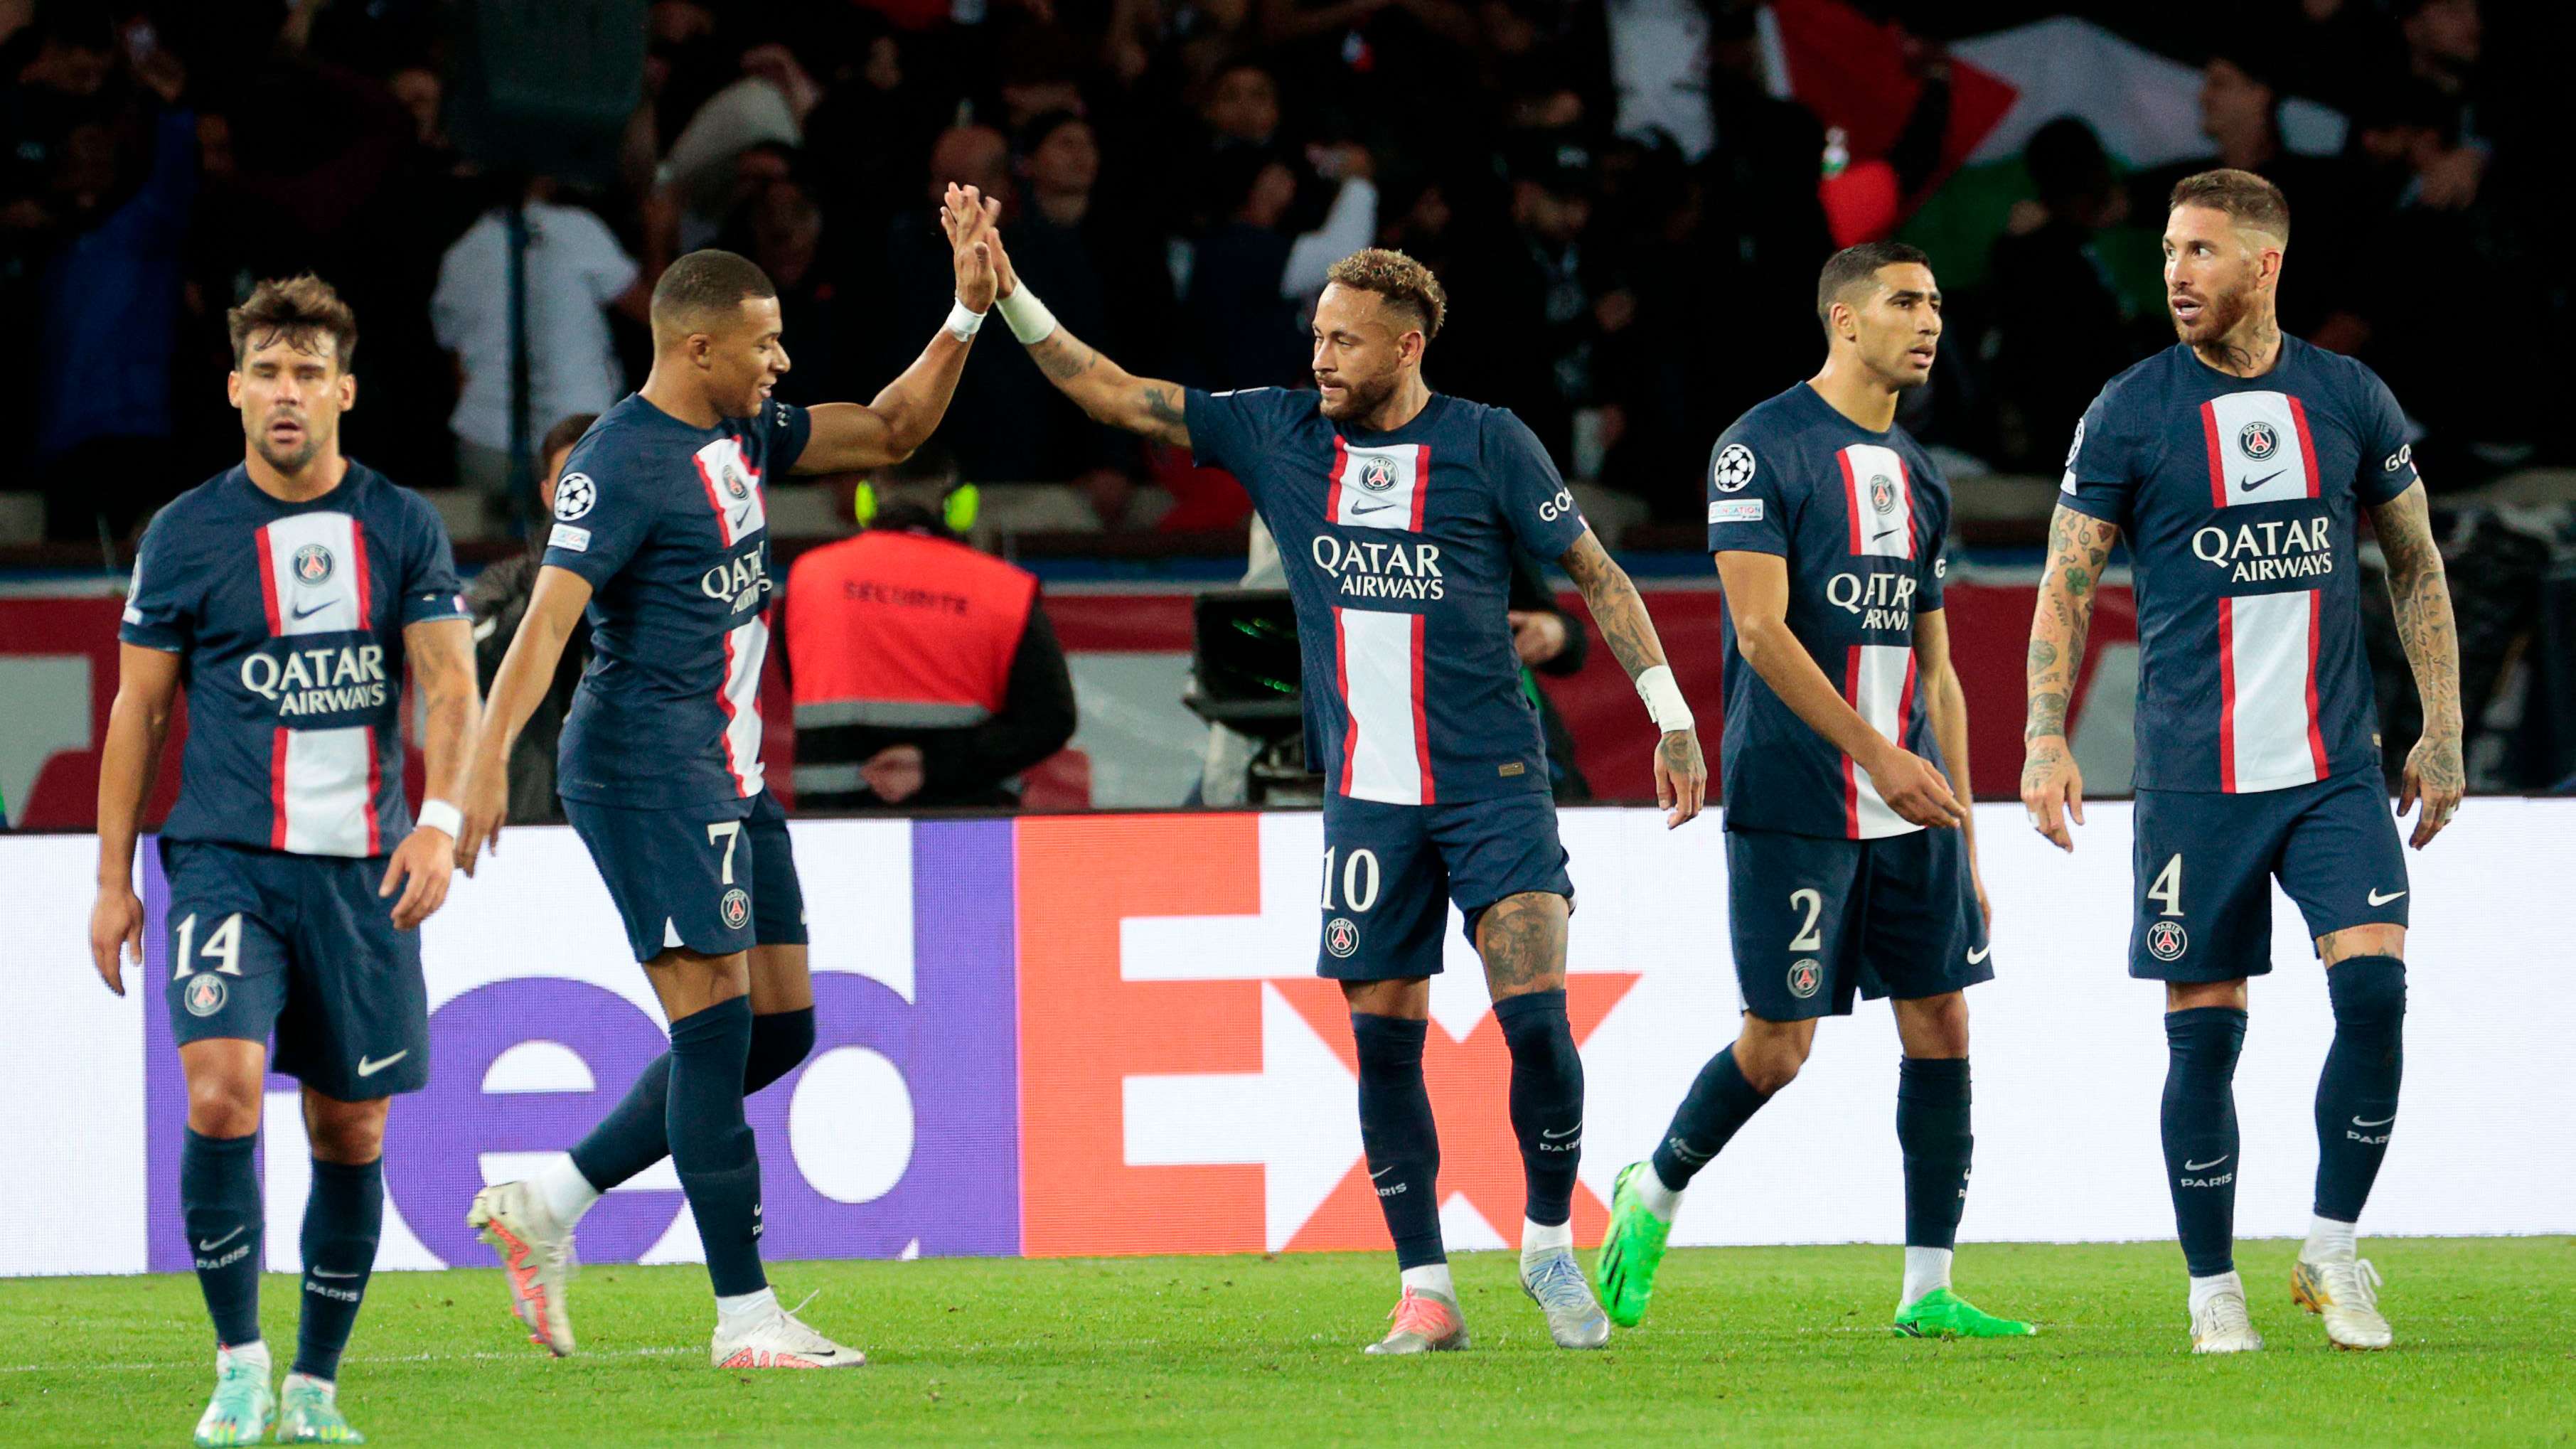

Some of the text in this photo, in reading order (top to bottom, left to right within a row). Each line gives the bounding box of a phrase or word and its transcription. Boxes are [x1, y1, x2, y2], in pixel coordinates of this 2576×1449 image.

[2385, 444, 2412, 472] GO
[1539, 486, 1575, 522] GOA
[1313, 535, 1443, 578] QATAR
[2192, 516, 2331, 569] QATAR
[2231, 552, 2333, 583] AIRWAYS
[1340, 574, 1444, 600] AIRWAYS
[241, 644, 386, 700] QATAR
[279, 682, 387, 717] AIRWAYS
[707, 820, 741, 884] 7
[1321, 845, 1380, 912] 10
[2147, 853, 2185, 916] 4
[1330, 920, 1353, 931] PARIS
[1789, 888, 1822, 951] 2
[2154, 923, 2181, 934] PARIS
[173, 913, 243, 980] 14
[144, 812, 1644, 1273] edEx
[1539, 1138, 1581, 1153] PARI
[2346, 1130, 2390, 1145] PAR
[1377, 1182, 1407, 1197] RIS
[2181, 1172, 2233, 1187] PARIS
[196, 1244, 250, 1270] PARIS
[305, 1280, 360, 1303] PARIS
